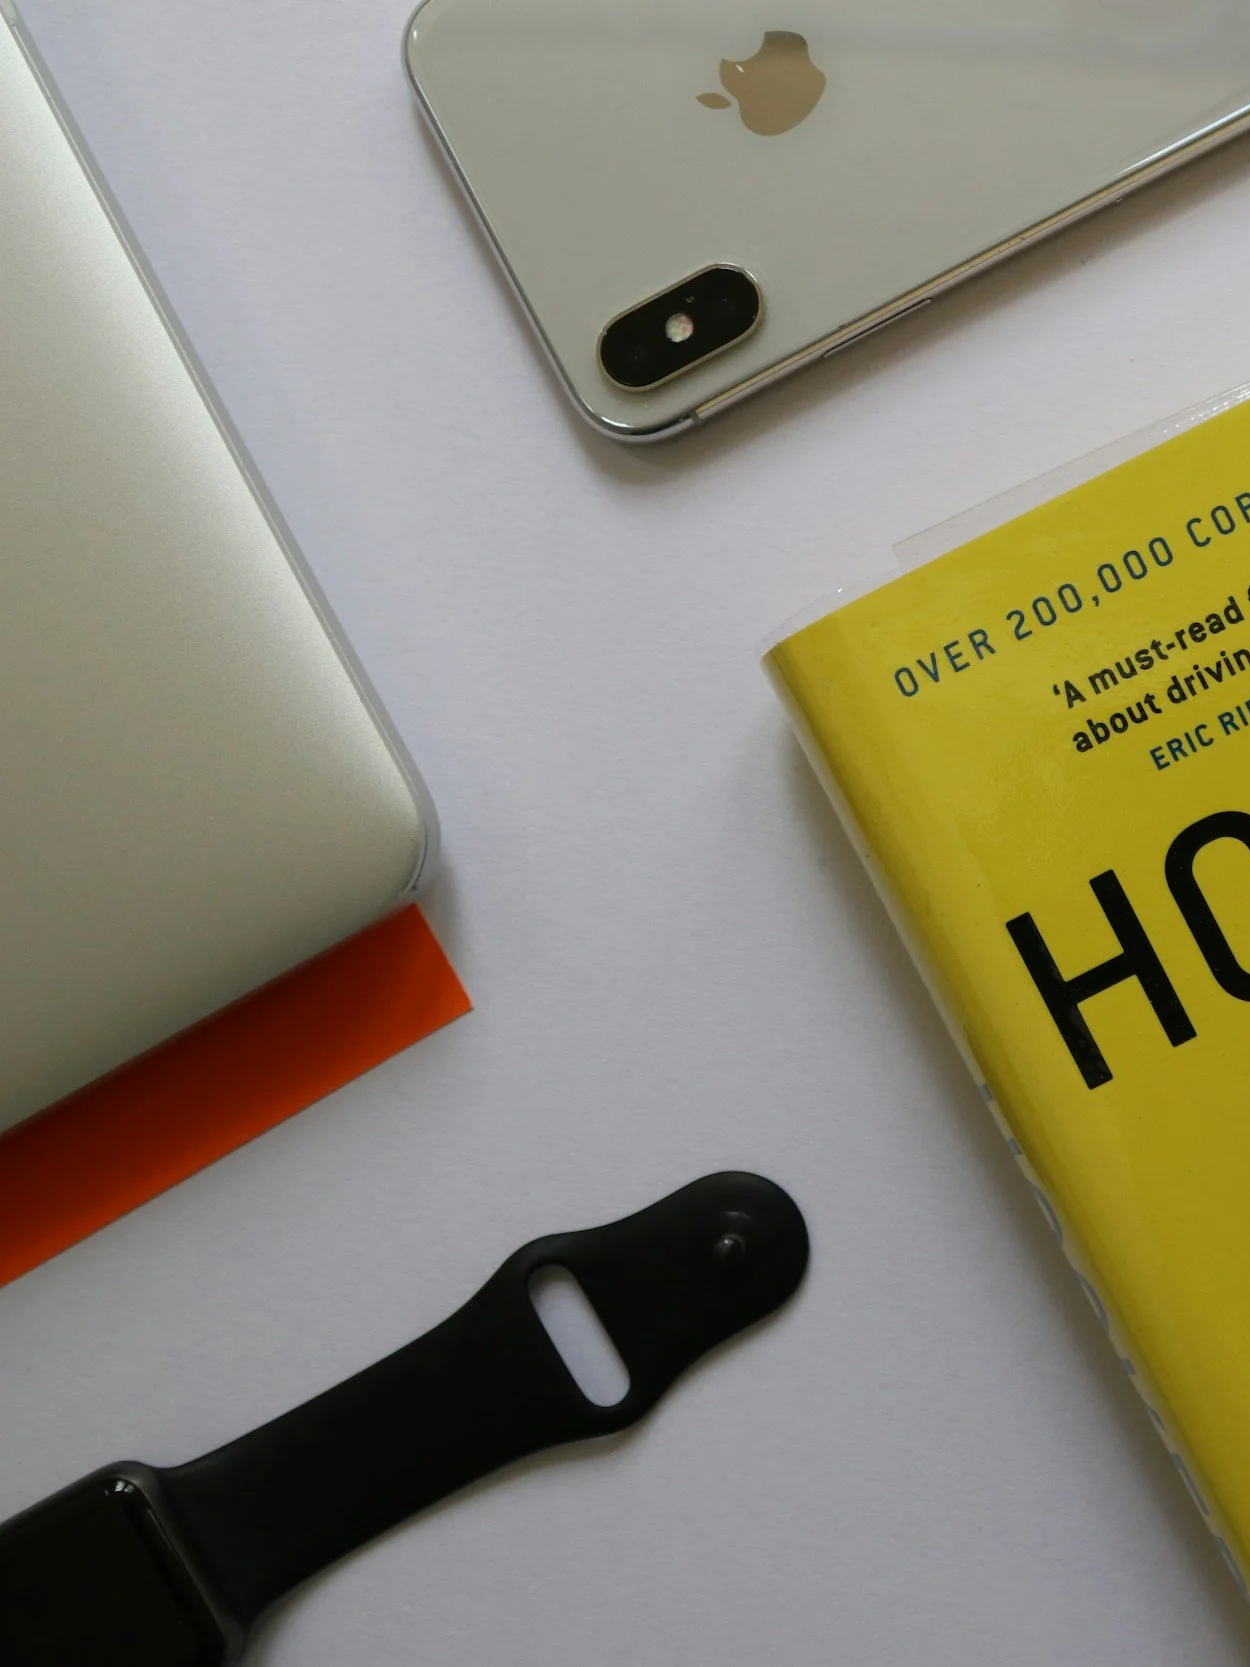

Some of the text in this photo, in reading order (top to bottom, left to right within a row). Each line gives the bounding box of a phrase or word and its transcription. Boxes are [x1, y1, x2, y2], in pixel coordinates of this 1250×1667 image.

[894, 628, 997, 698] OVER
[1005, 536, 1174, 641] 200,000
[1087, 595, 1245, 695] must-read
[1072, 692, 1163, 753] about
[1149, 723, 1214, 771] ERIC
